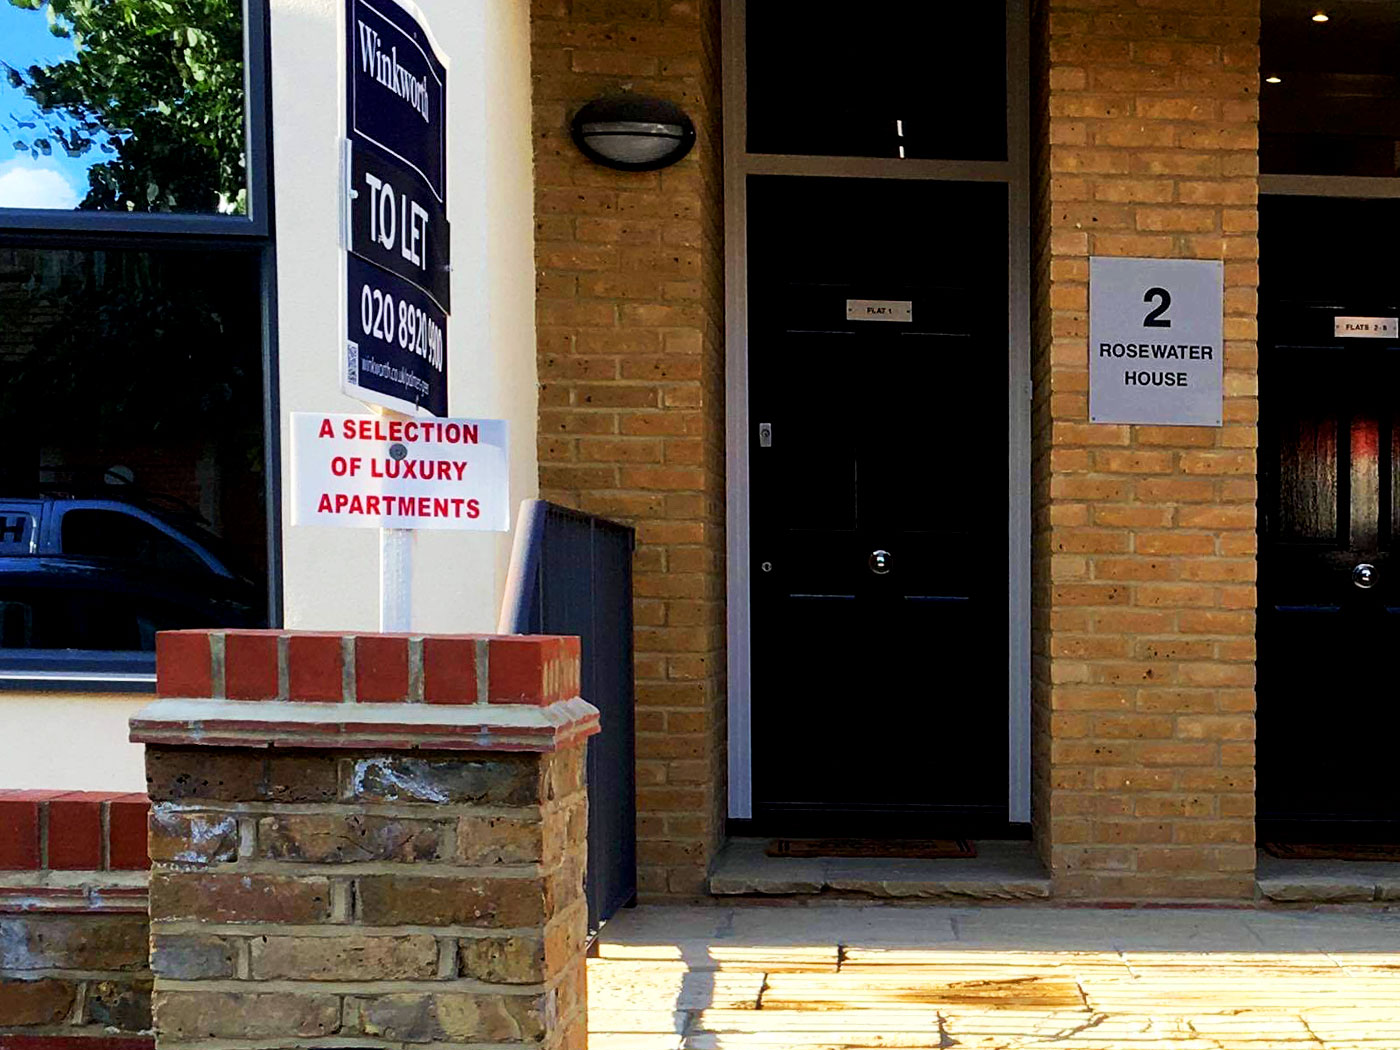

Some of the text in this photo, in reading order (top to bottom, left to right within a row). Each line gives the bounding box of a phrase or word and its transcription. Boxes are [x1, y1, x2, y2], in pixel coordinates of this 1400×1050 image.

[358, 20, 429, 123] Winkworth
[365, 171, 429, 271] TO LET
[866, 307, 887, 315] FLAT
[1143, 287, 1172, 328] 2
[361, 284, 395, 343] 020
[398, 299, 428, 359] 8920
[1099, 343, 1213, 360] ROSEWATER
[1124, 371, 1188, 387] HOUSE
[318, 418, 479, 445] A SELECTION
[331, 456, 468, 481] OF LUXURY
[317, 493, 480, 519] APARTMENTS
